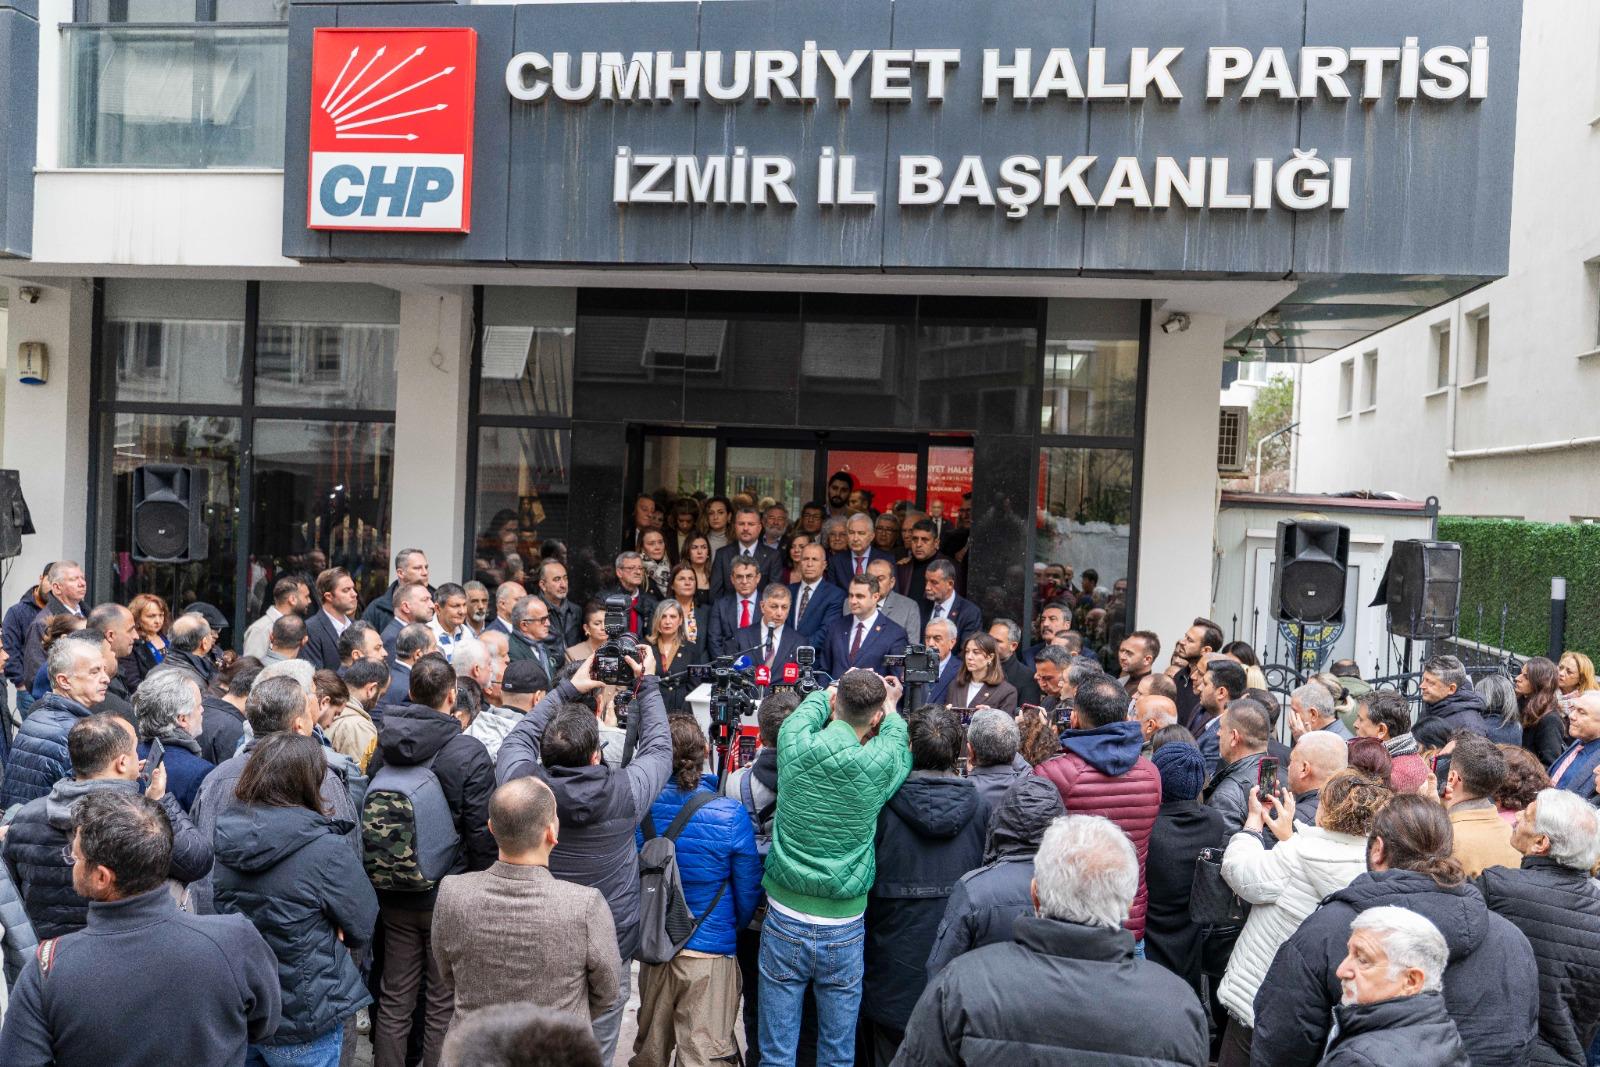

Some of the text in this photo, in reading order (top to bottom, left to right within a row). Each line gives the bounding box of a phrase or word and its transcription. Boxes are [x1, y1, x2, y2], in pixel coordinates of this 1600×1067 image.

[505, 36, 1489, 102] CUMHURİYET HALK PARTİSİ
[319, 163, 455, 218] CHP
[613, 146, 1351, 219] İZMİR İL BAŞKANLIĞI
[947, 465, 968, 474] HALK
